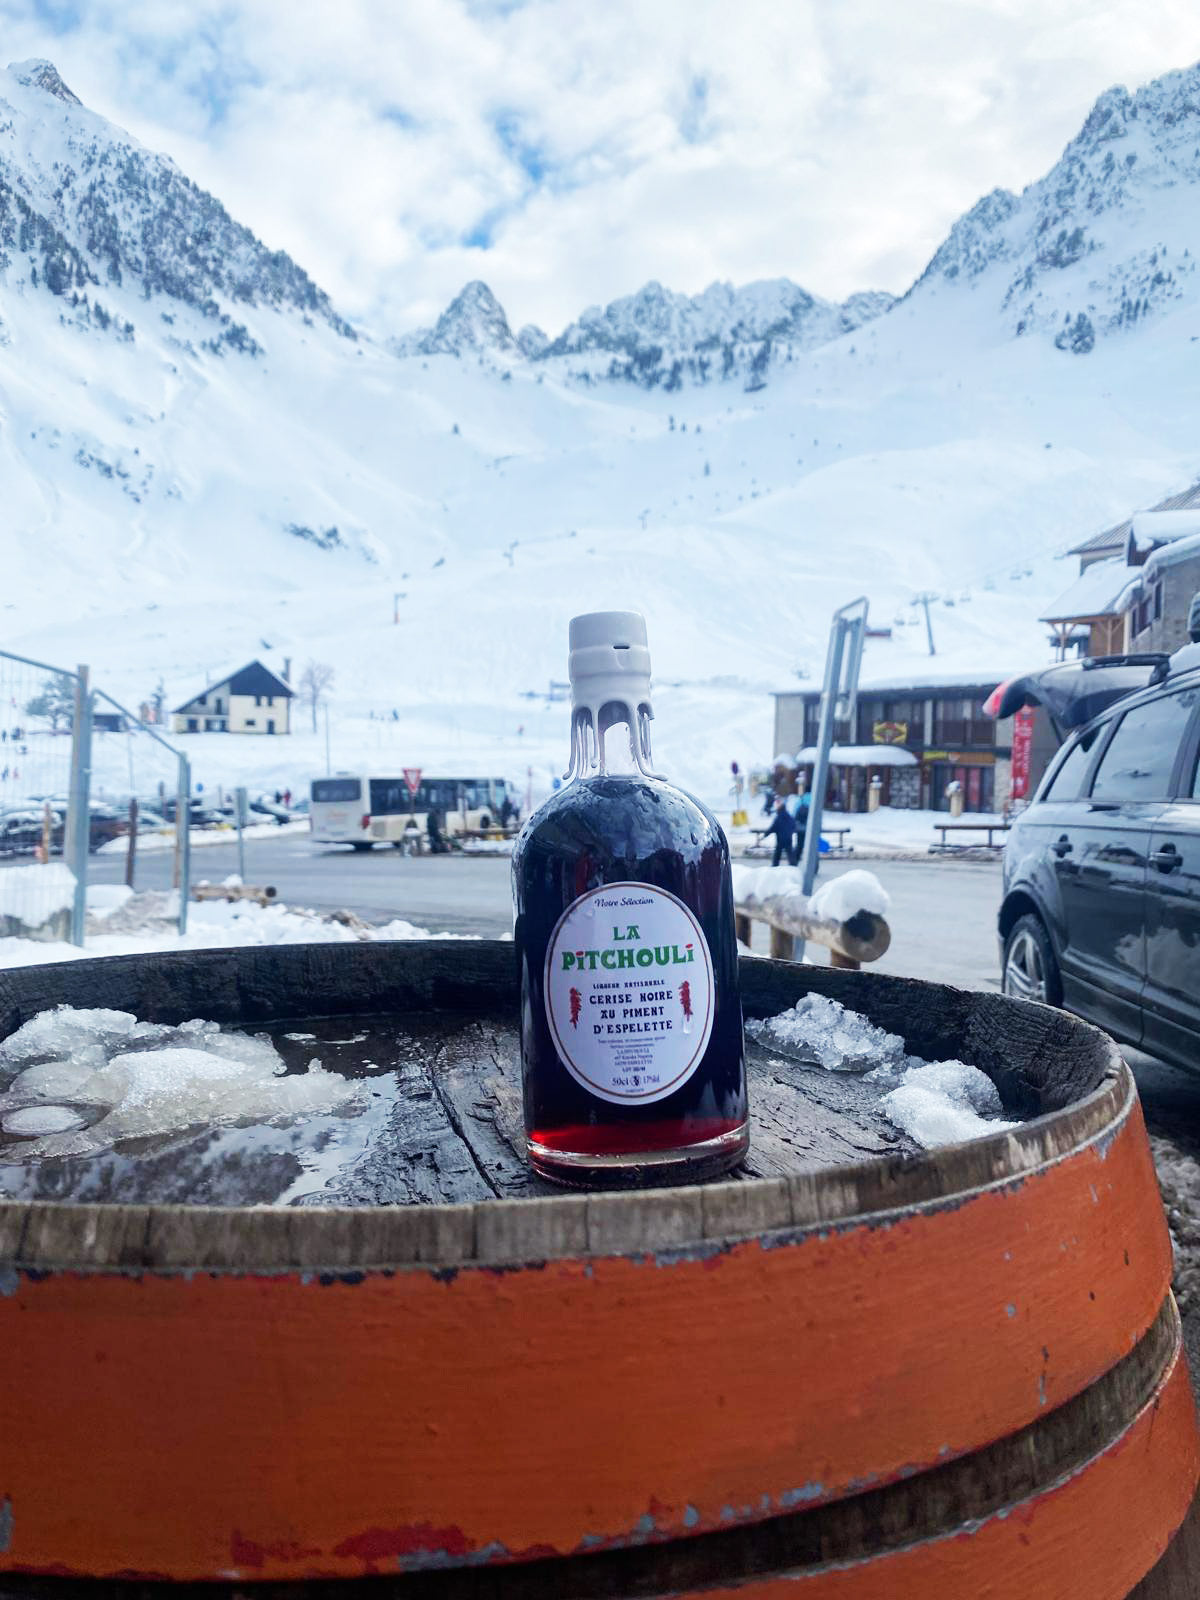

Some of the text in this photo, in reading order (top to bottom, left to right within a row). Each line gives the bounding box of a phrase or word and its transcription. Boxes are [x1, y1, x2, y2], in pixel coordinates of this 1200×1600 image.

[612, 925, 641, 941] LA
[589, 990, 673, 1005] CERISE NOIRE
[600, 1006, 665, 1020] AU PIMENT
[593, 1020, 673, 1035] D'ESPELETTE
